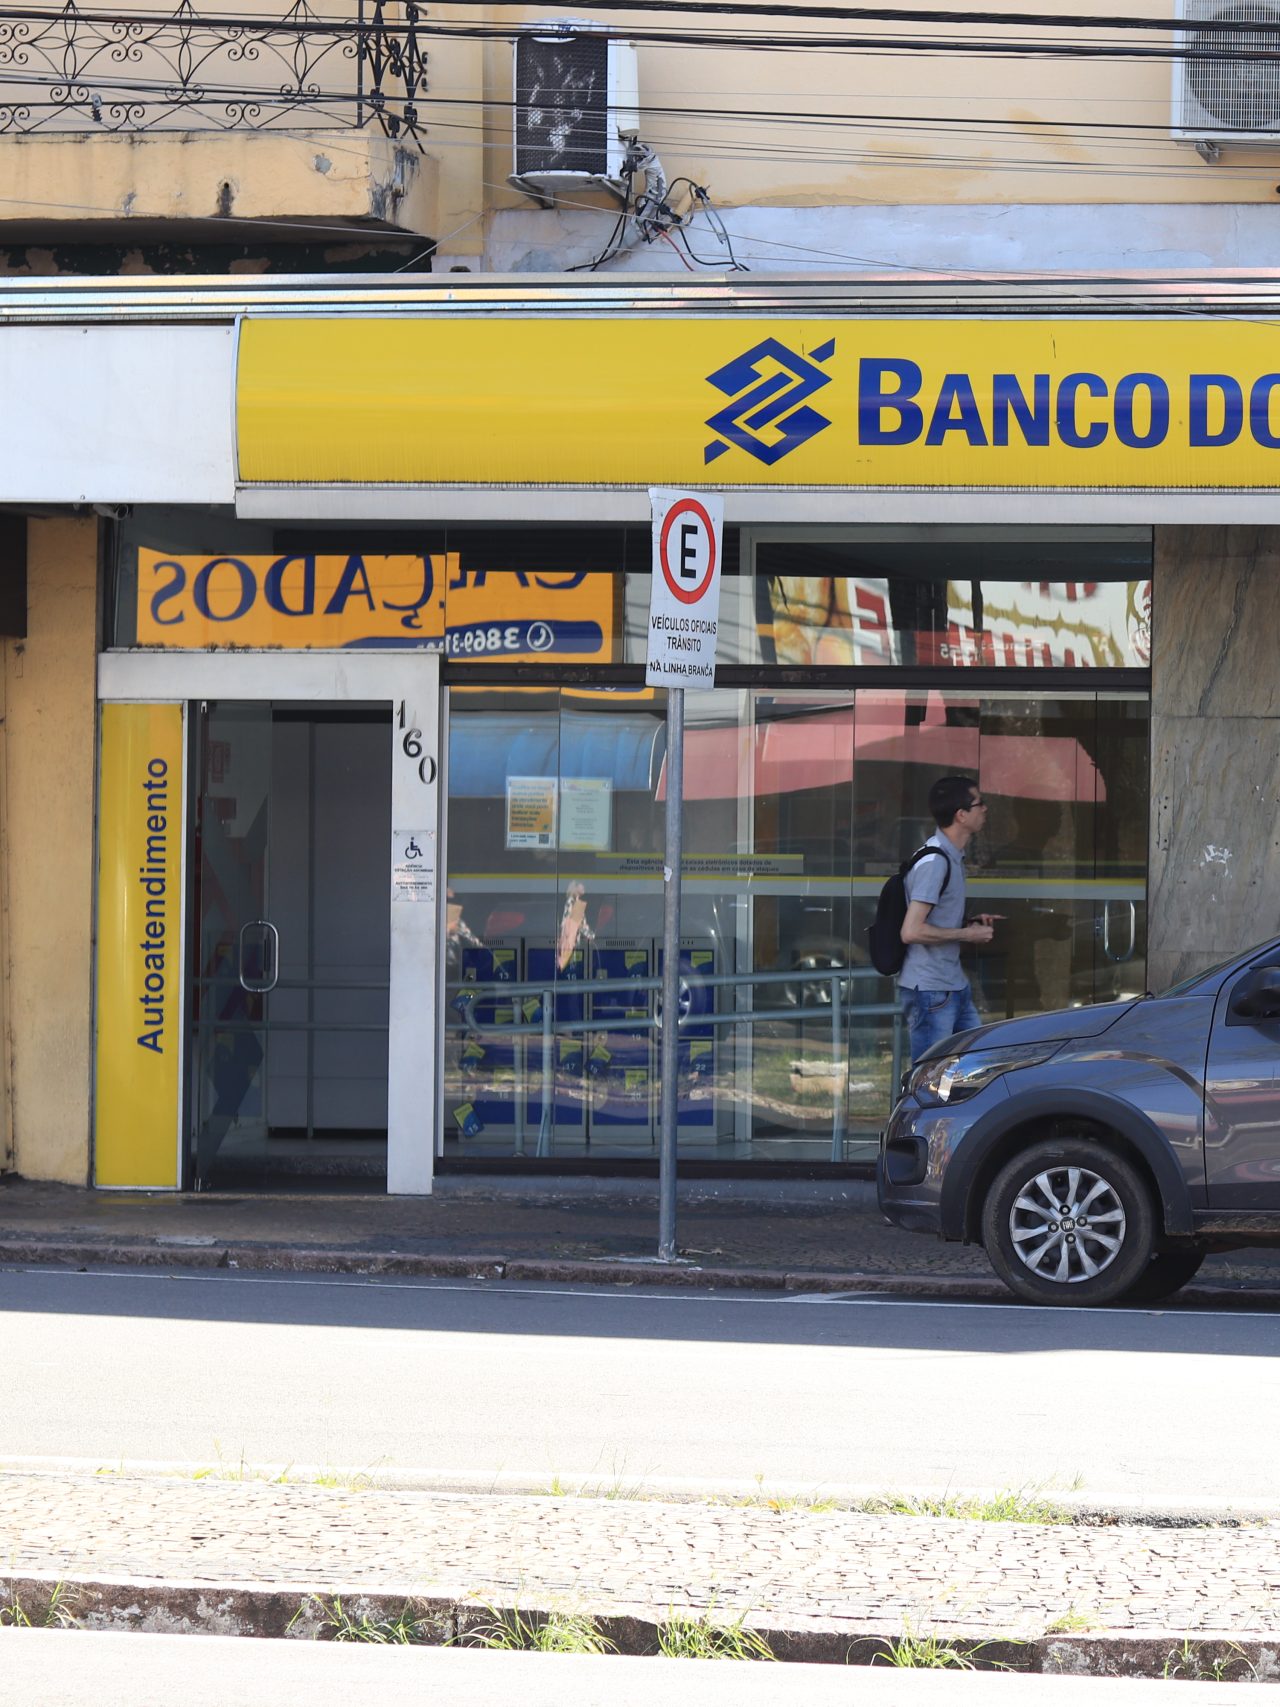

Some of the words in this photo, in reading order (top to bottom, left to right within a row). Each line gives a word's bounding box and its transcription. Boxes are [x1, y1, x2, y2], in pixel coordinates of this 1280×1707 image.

[858, 357, 1170, 449] BANCO
[680, 523, 698, 579] E
[651, 613, 689, 632] VEÍCULOS
[690, 619, 717, 635] OFICIAIS
[667, 634, 702, 652] TRÂNSITO
[663, 662, 687, 674] LINHA
[688, 664, 713, 677] BRANCA
[395, 700, 437, 785] 160
[137, 757, 168, 1054] Autoatendimento
[499, 972, 509, 981] 13
[695, 1063, 706, 1071] 22
